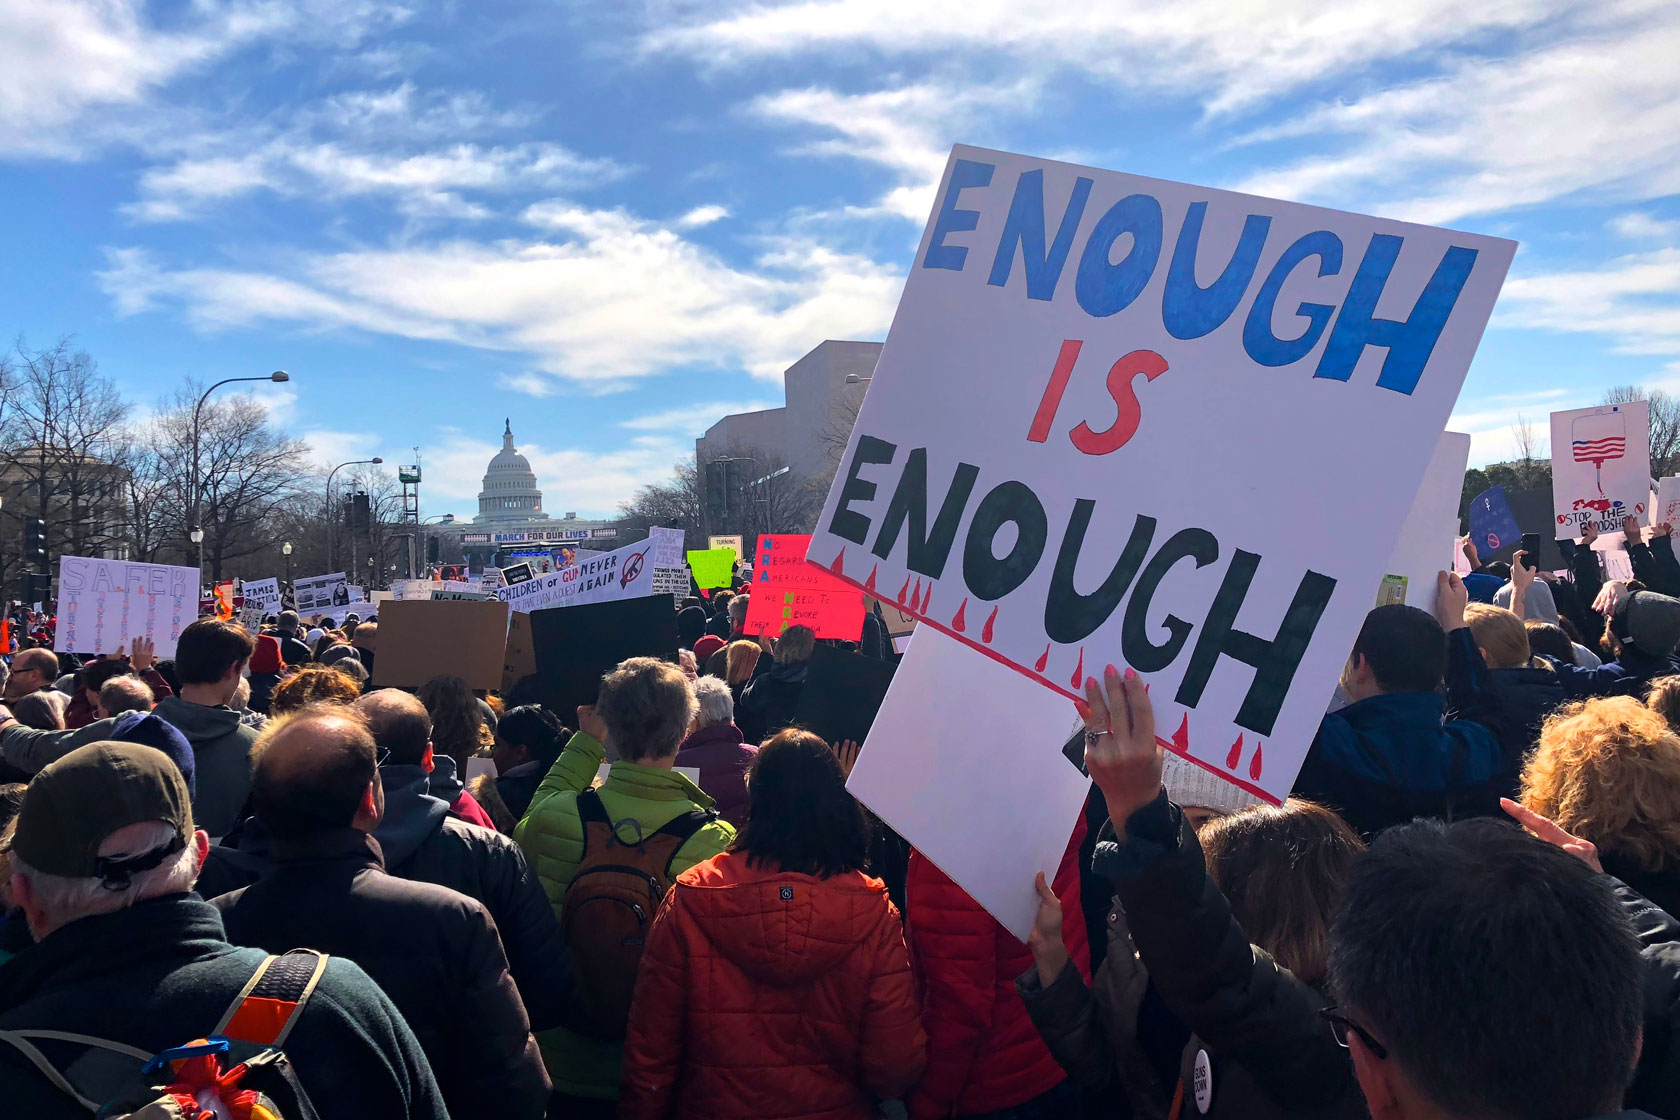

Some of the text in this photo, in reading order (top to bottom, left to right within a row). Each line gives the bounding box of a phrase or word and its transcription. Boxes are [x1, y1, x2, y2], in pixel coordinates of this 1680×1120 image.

[923, 160, 1479, 396] ENOUGH
[1026, 340, 1169, 456] IS
[1564, 506, 1626, 526] STOP THE
[494, 530, 589, 542] MARCH FOR OUR LIVES
[580, 555, 617, 577] NEVER
[62, 558, 186, 597] SAFER
[577, 571, 615, 594] AGAIN
[828, 434, 1338, 738] ENOUGH
[245, 584, 275, 598] JAMES
[498, 579, 543, 602] CHILDREN
[1195, 1065, 1206, 1080] GUNS
[1194, 1078, 1208, 1093] DOWN
